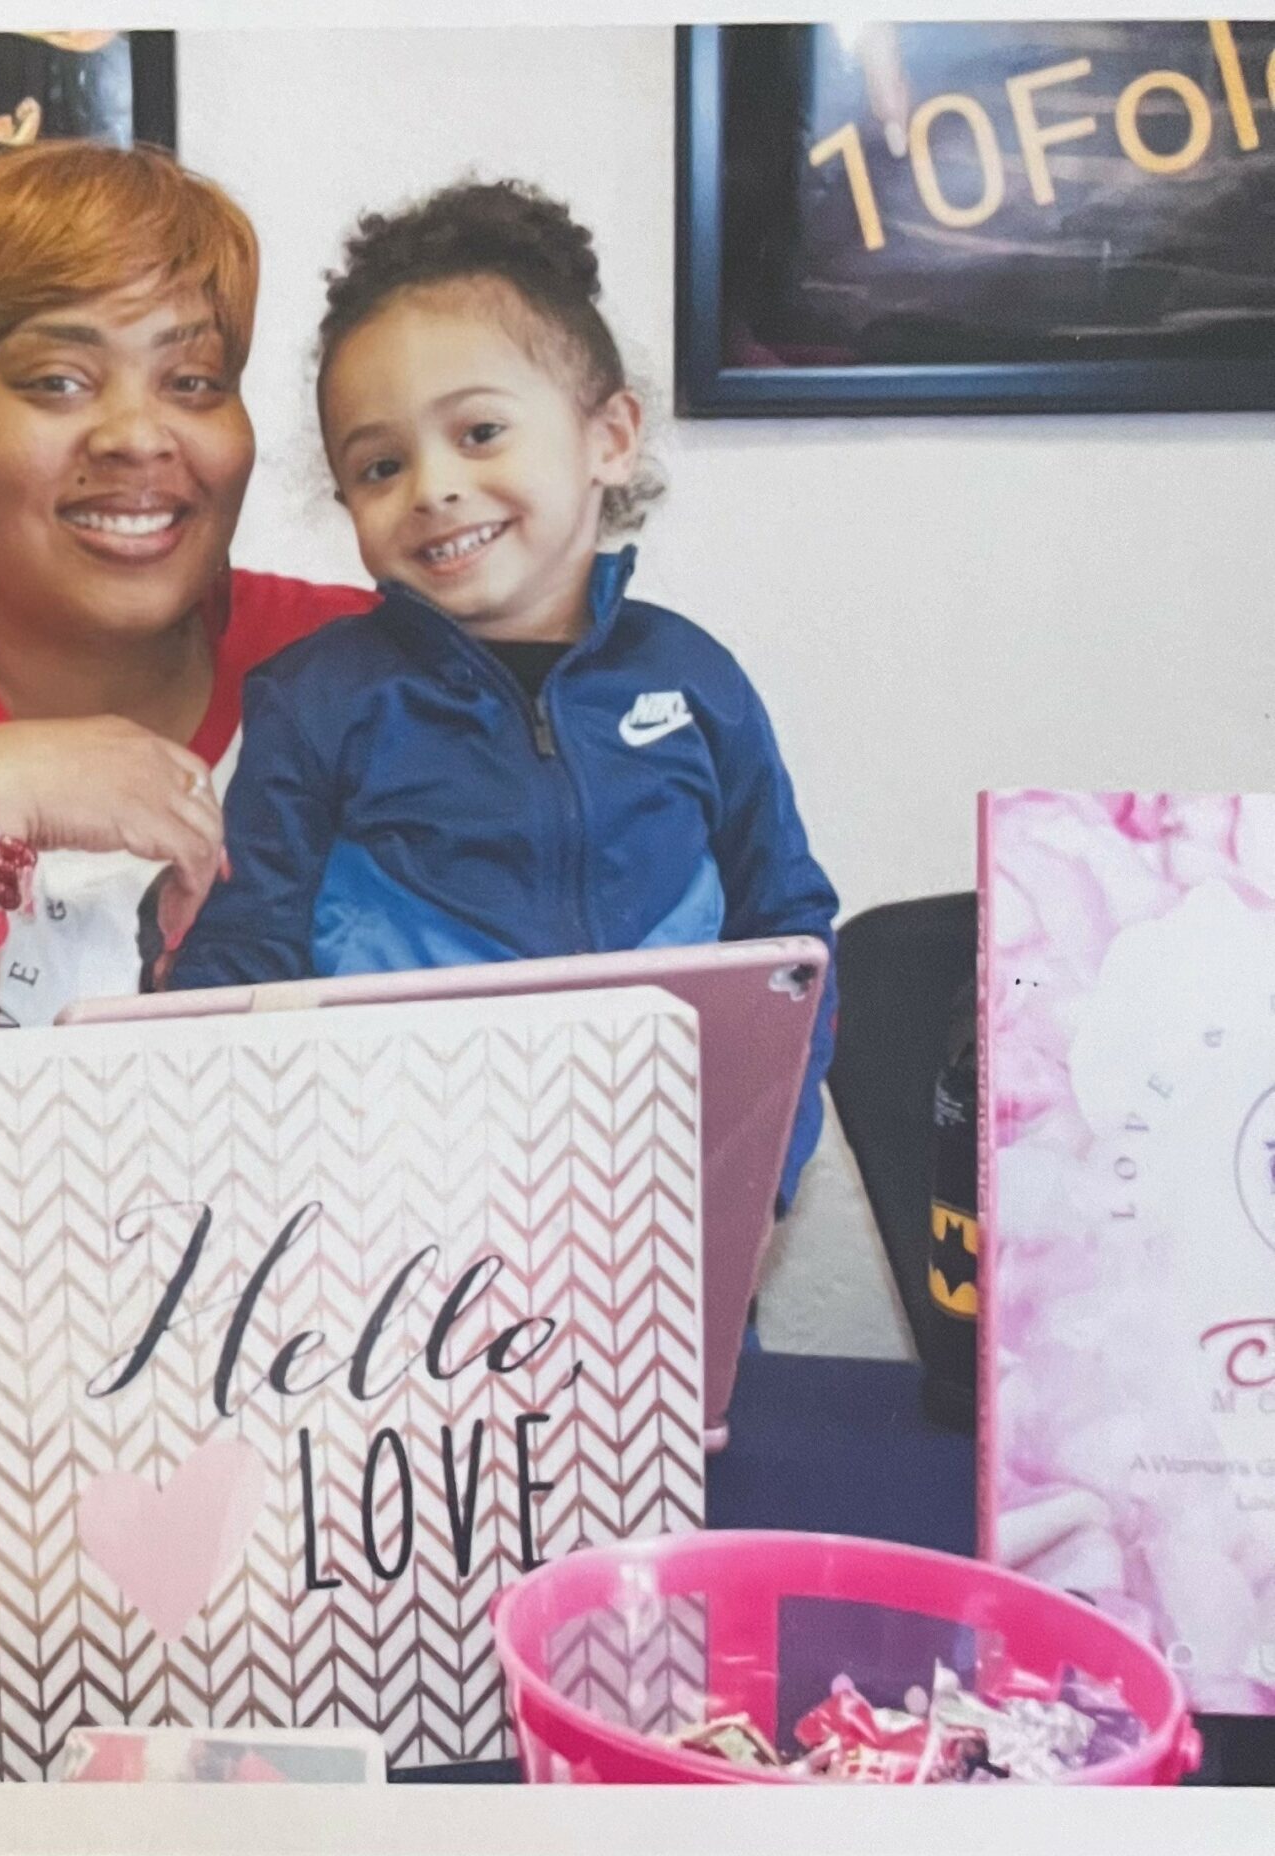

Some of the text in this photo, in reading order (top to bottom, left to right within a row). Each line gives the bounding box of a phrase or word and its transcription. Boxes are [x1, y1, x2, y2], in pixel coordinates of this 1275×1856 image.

[808, 20, 1275, 251] 10Fol
[628, 691, 688, 725] NIKE
[86, 1200, 583, 1418] Hello,
[299, 1412, 555, 1591] LOVE
